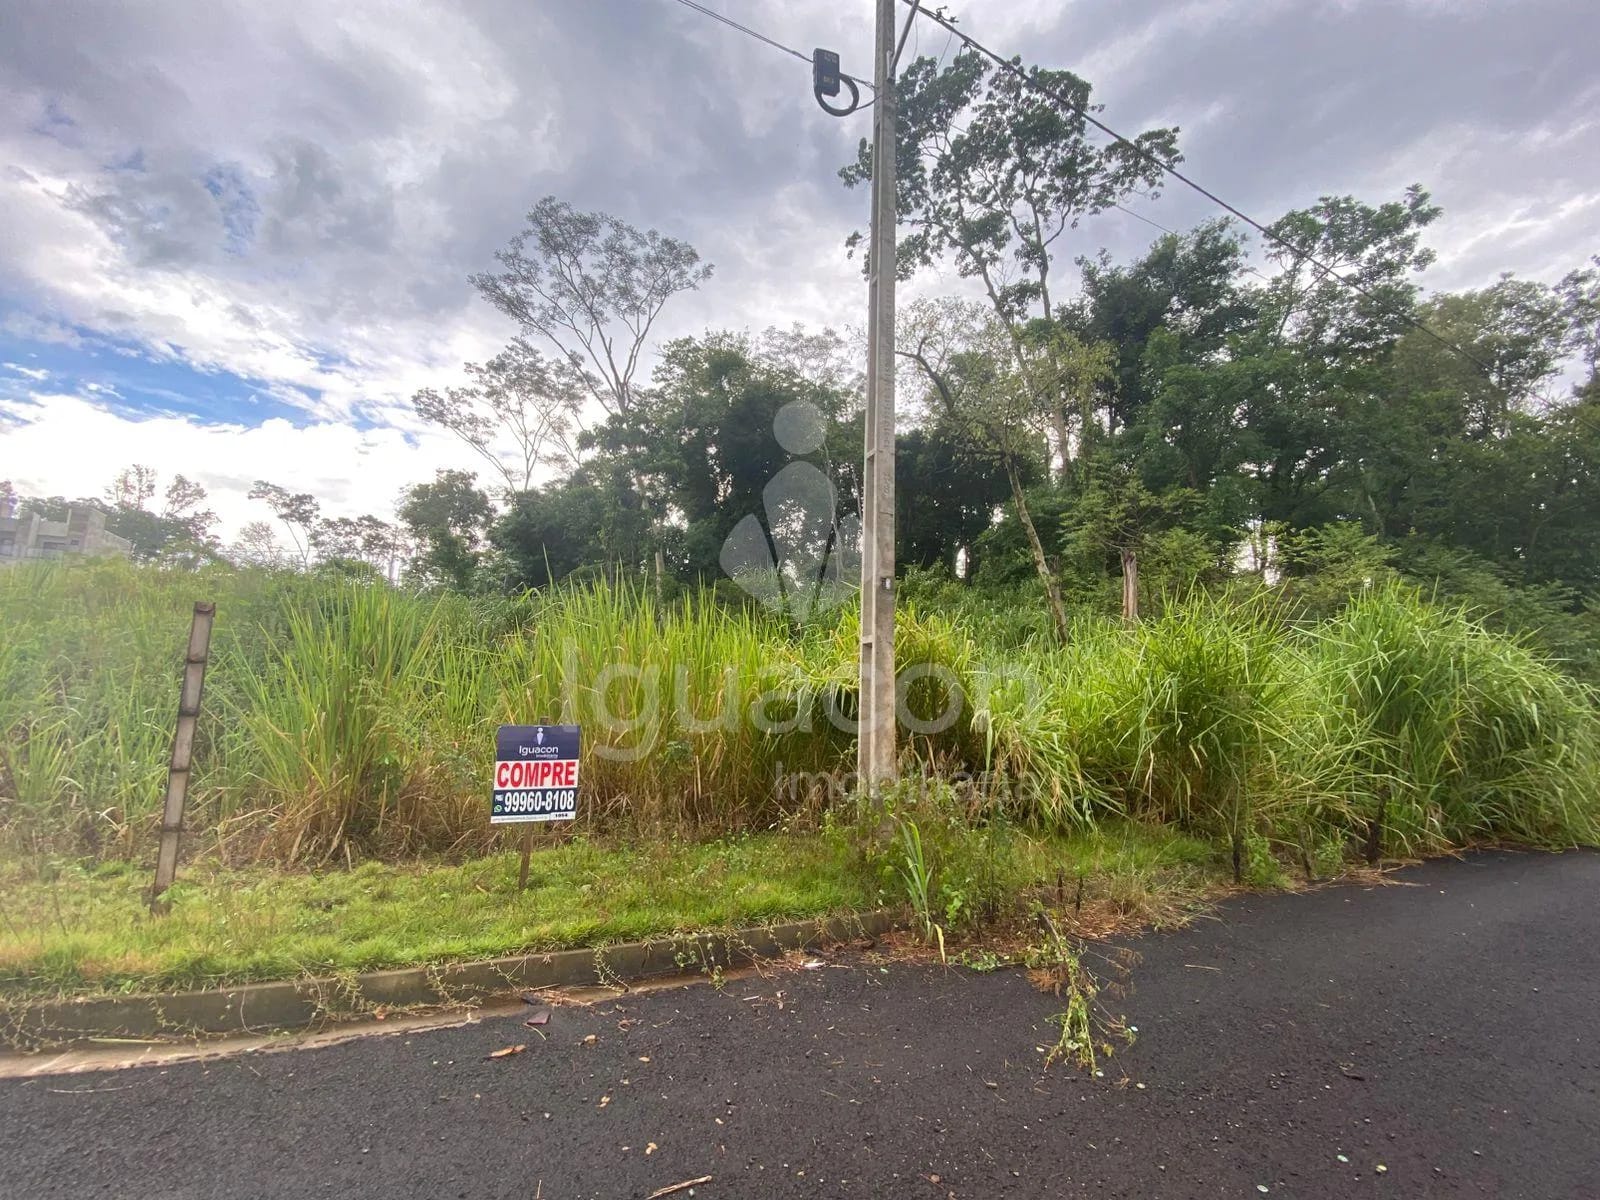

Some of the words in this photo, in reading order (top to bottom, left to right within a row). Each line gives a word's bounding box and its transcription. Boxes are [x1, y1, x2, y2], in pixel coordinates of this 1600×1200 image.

[519, 745, 558, 756] Iguacon
[498, 762, 576, 788] COMPRE
[504, 790, 574, 812] 99960-8108
